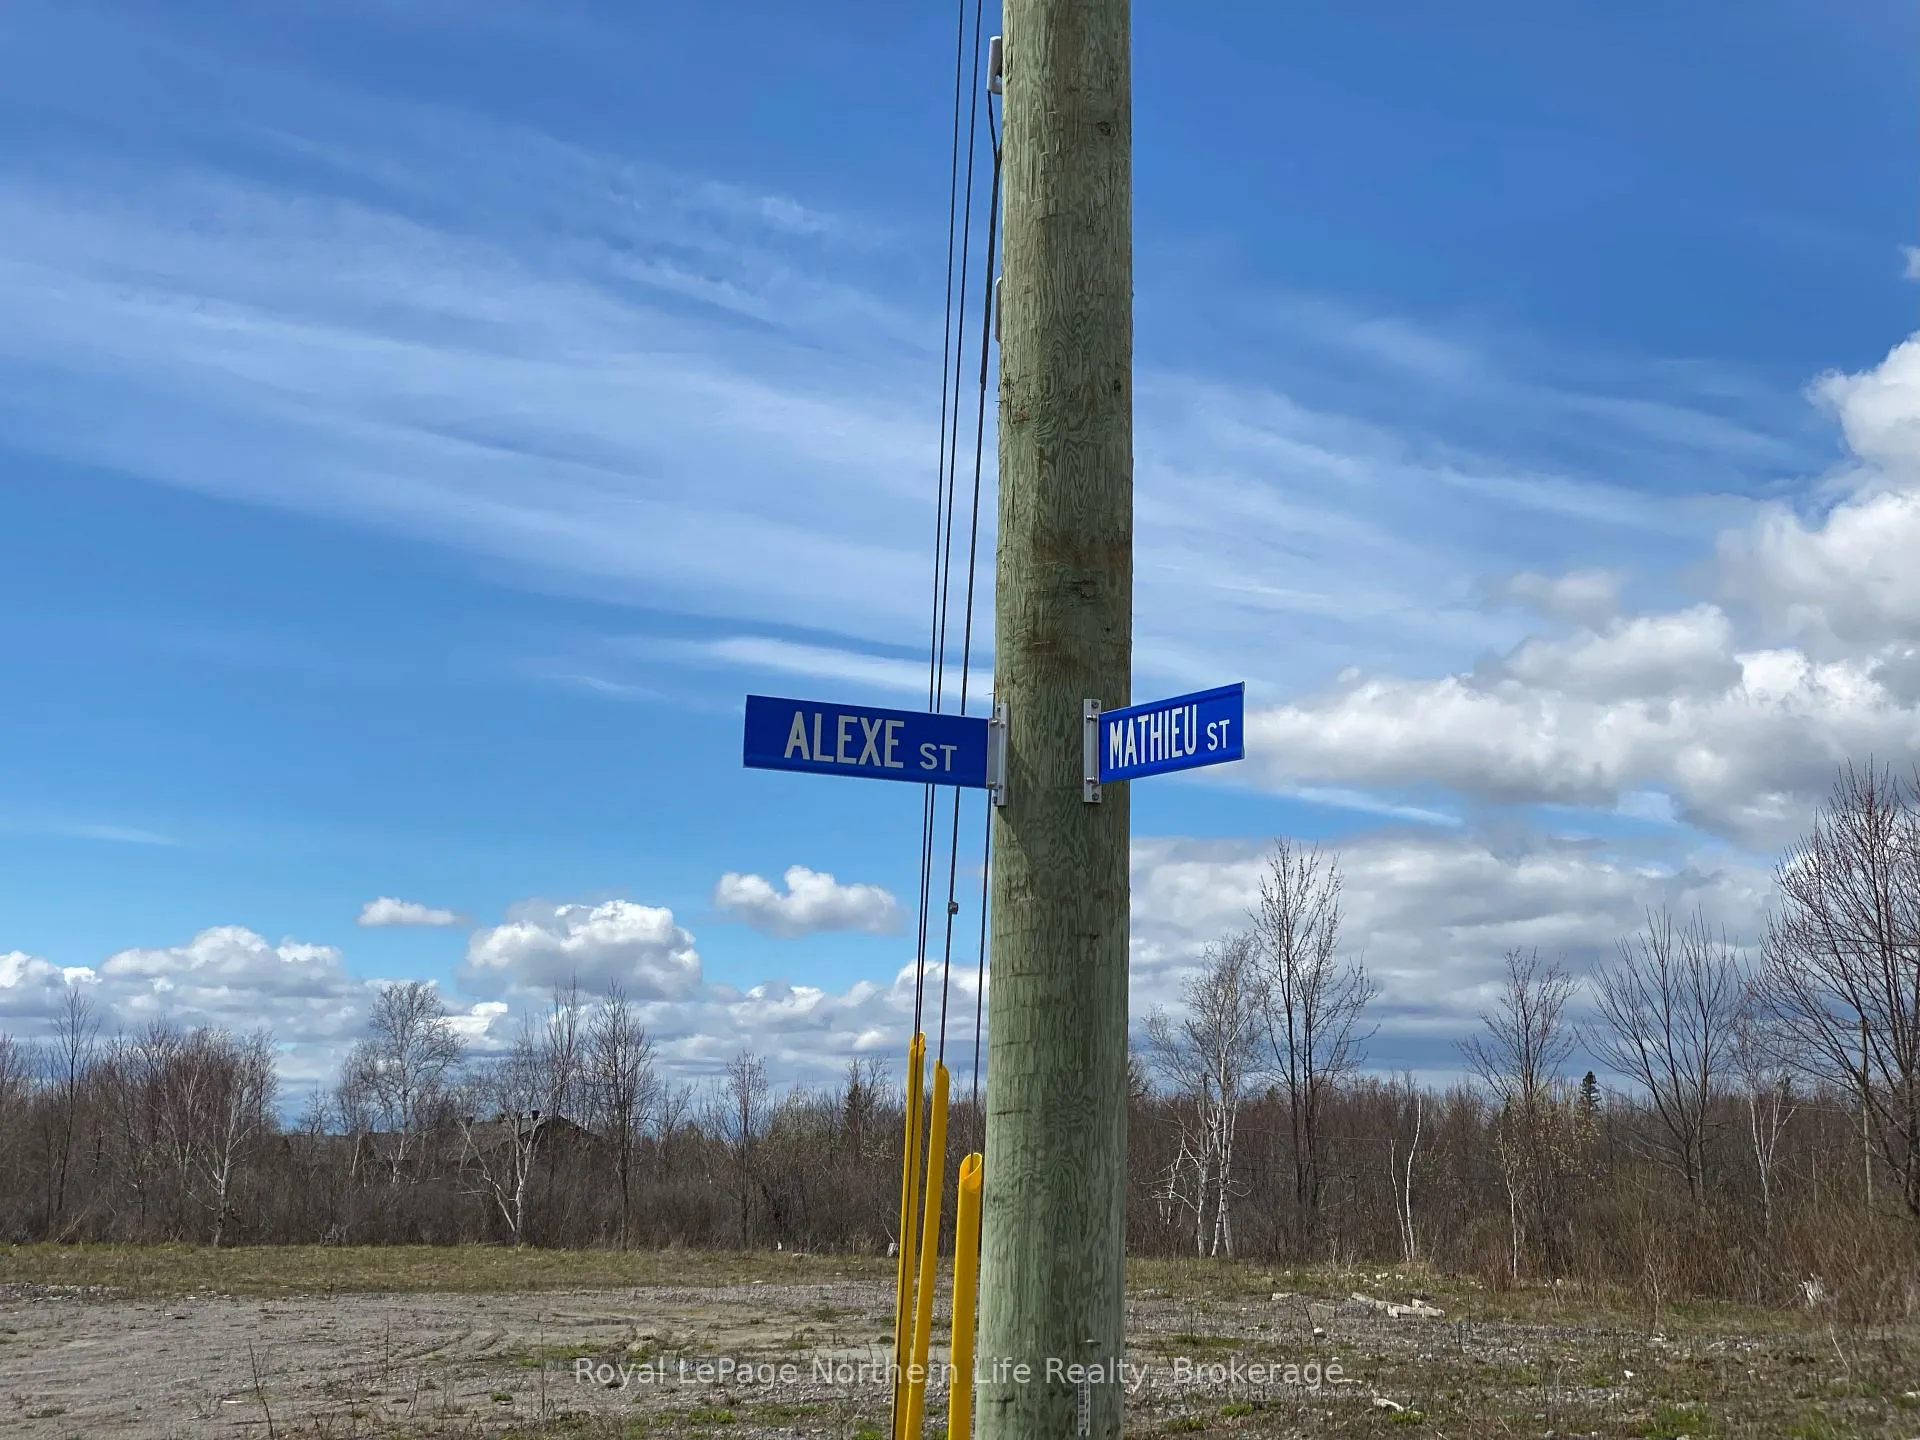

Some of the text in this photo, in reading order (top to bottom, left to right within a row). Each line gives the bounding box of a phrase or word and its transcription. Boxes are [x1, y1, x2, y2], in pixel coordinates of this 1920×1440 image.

[784, 711, 958, 772] ALEXE ST
[1109, 704, 1231, 770] MATHIEU ST
